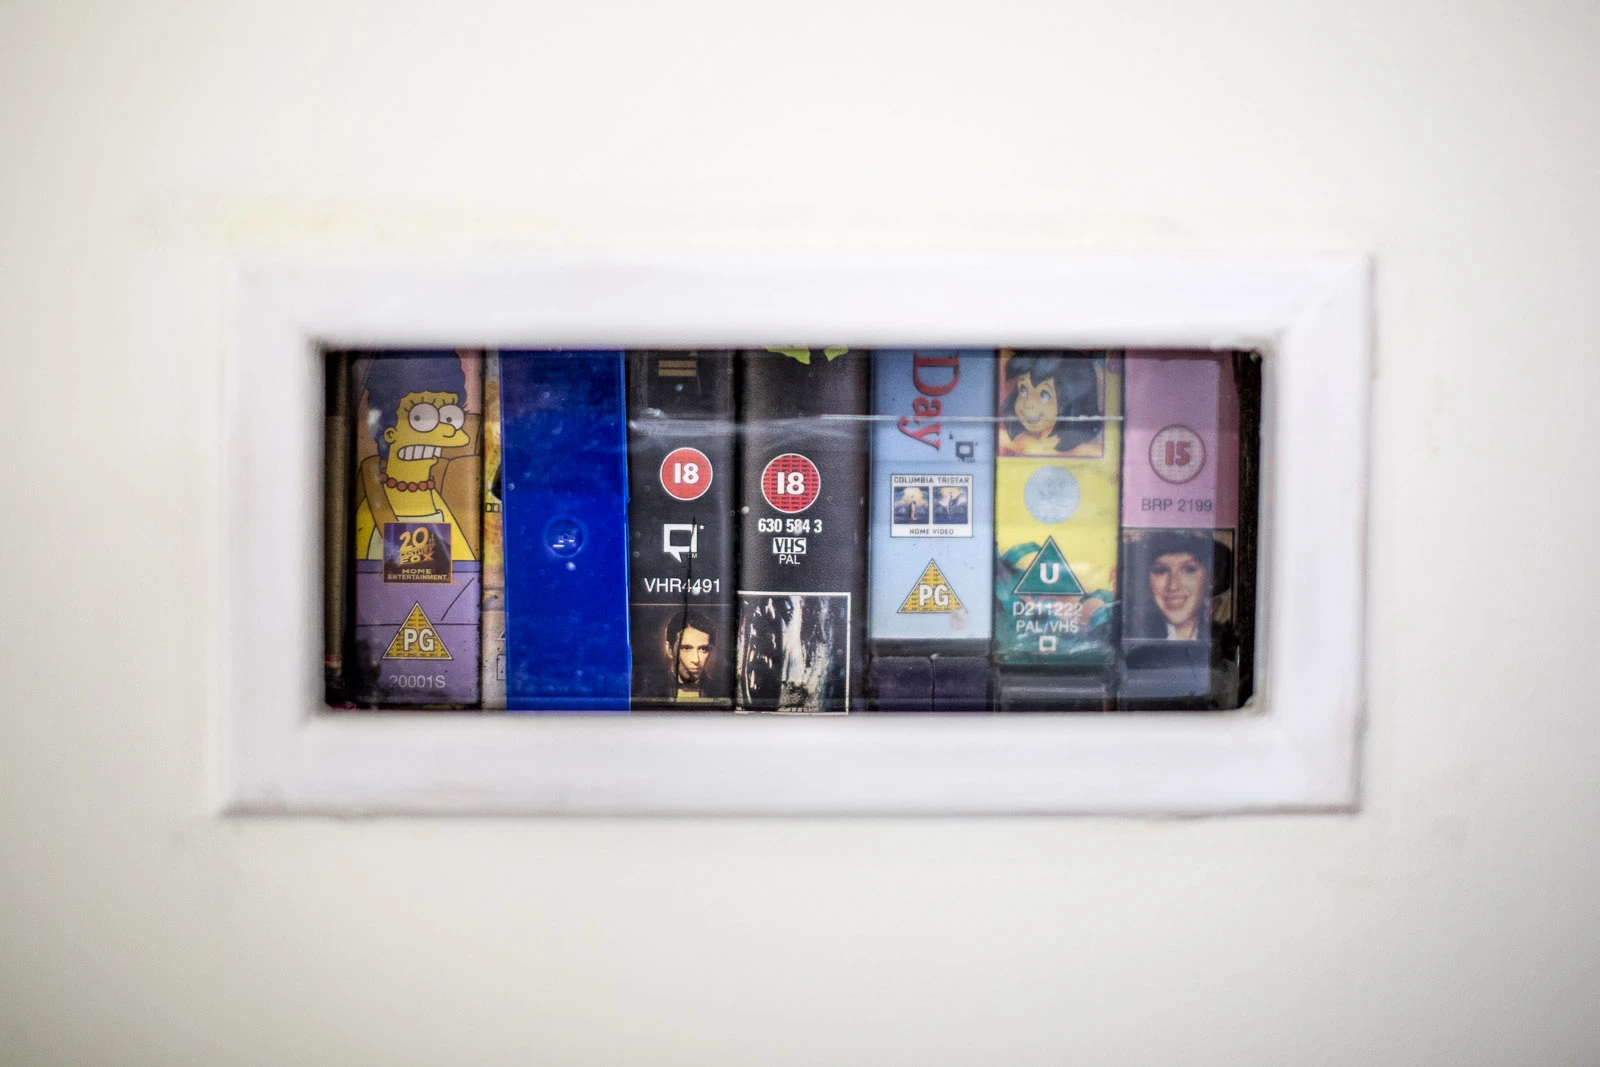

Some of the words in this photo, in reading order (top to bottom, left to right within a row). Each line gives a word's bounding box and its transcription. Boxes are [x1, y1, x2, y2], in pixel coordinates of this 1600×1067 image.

[897, 352, 960, 452] Day
[1165, 441, 1191, 466] 15
[674, 462, 700, 485] 18
[893, 476, 934, 484] COLUMBIA
[777, 471, 805, 495] 18
[1141, 498, 1173, 511] BRP
[1177, 499, 1213, 512] 2199
[758, 518, 782, 533] 630
[786, 519, 810, 534] 584
[813, 519, 823, 533] 3
[774, 538, 805, 553] VHS
[779, 554, 800, 565] PAL
[1040, 563, 1060, 584] U
[644, 578, 720, 593] VHR4491
[919, 584, 949, 606] PG
[1016, 620, 1079, 633] PAL/VHS
[404, 628, 434, 652] PG
[389, 674, 446, 689] 20001S
